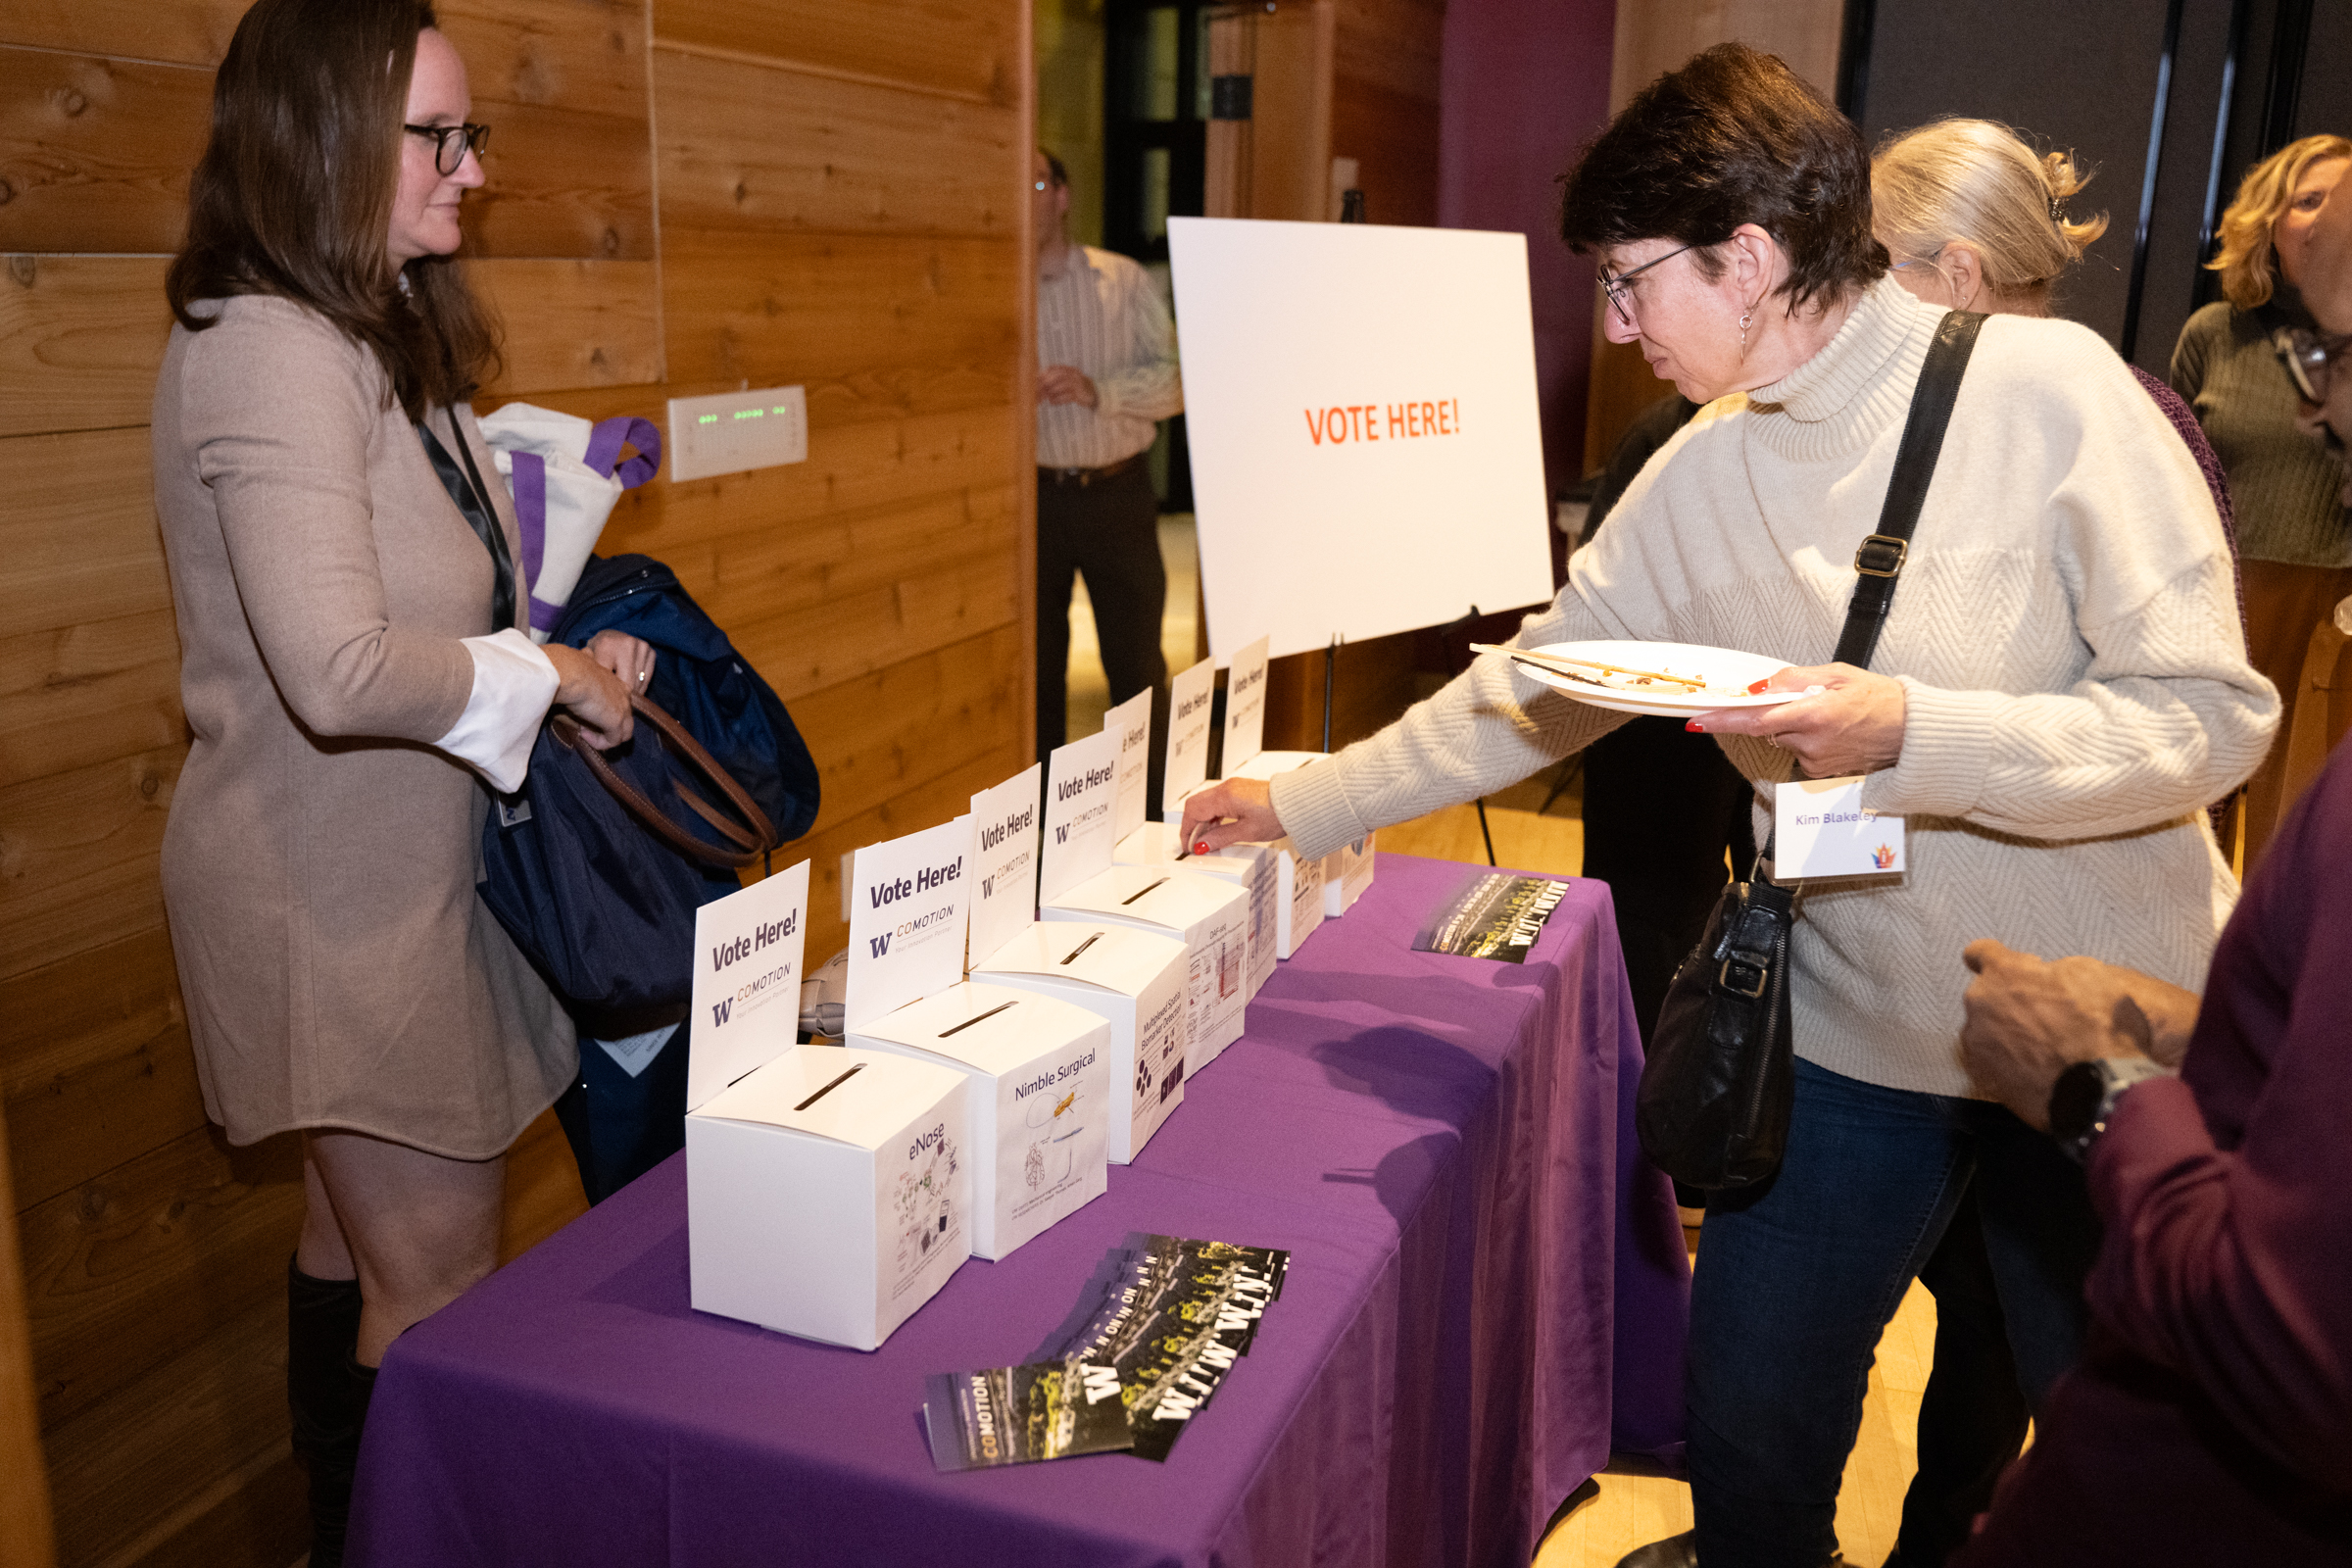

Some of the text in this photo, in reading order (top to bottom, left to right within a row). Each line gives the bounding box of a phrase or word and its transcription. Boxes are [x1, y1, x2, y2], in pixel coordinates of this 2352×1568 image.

[1305, 398, 1459, 446] VOTE HERE!
[1178, 699, 1192, 720] Vote
[1128, 720, 1146, 749] Here!
[1058, 776, 1083, 802] Vote
[1086, 760, 1114, 790] Here!
[982, 804, 1033, 852] Vote Here!
[1055, 822, 1070, 845] W
[1072, 803, 1108, 827] COMOTION
[1796, 810, 1877, 825] Kim Blakeley
[870, 877, 912, 908] Vote
[916, 856, 962, 893] Here!
[982, 874, 995, 900] W
[997, 850, 1030, 879] COMOTION
[712, 907, 797, 972] Vote Here!
[870, 904, 955, 959] W COMOTION
[712, 961, 791, 1028] W COMOTION
[1142, 1004, 1182, 1052] Biomarker Detection
[1015, 1048, 1095, 1102] Nimble Surgical
[909, 1123, 945, 1160] eNose
[1080, 1362, 1122, 1405] W
[1152, 1386, 1198, 1421] W
[971, 1376, 999, 1459] COMOTION
